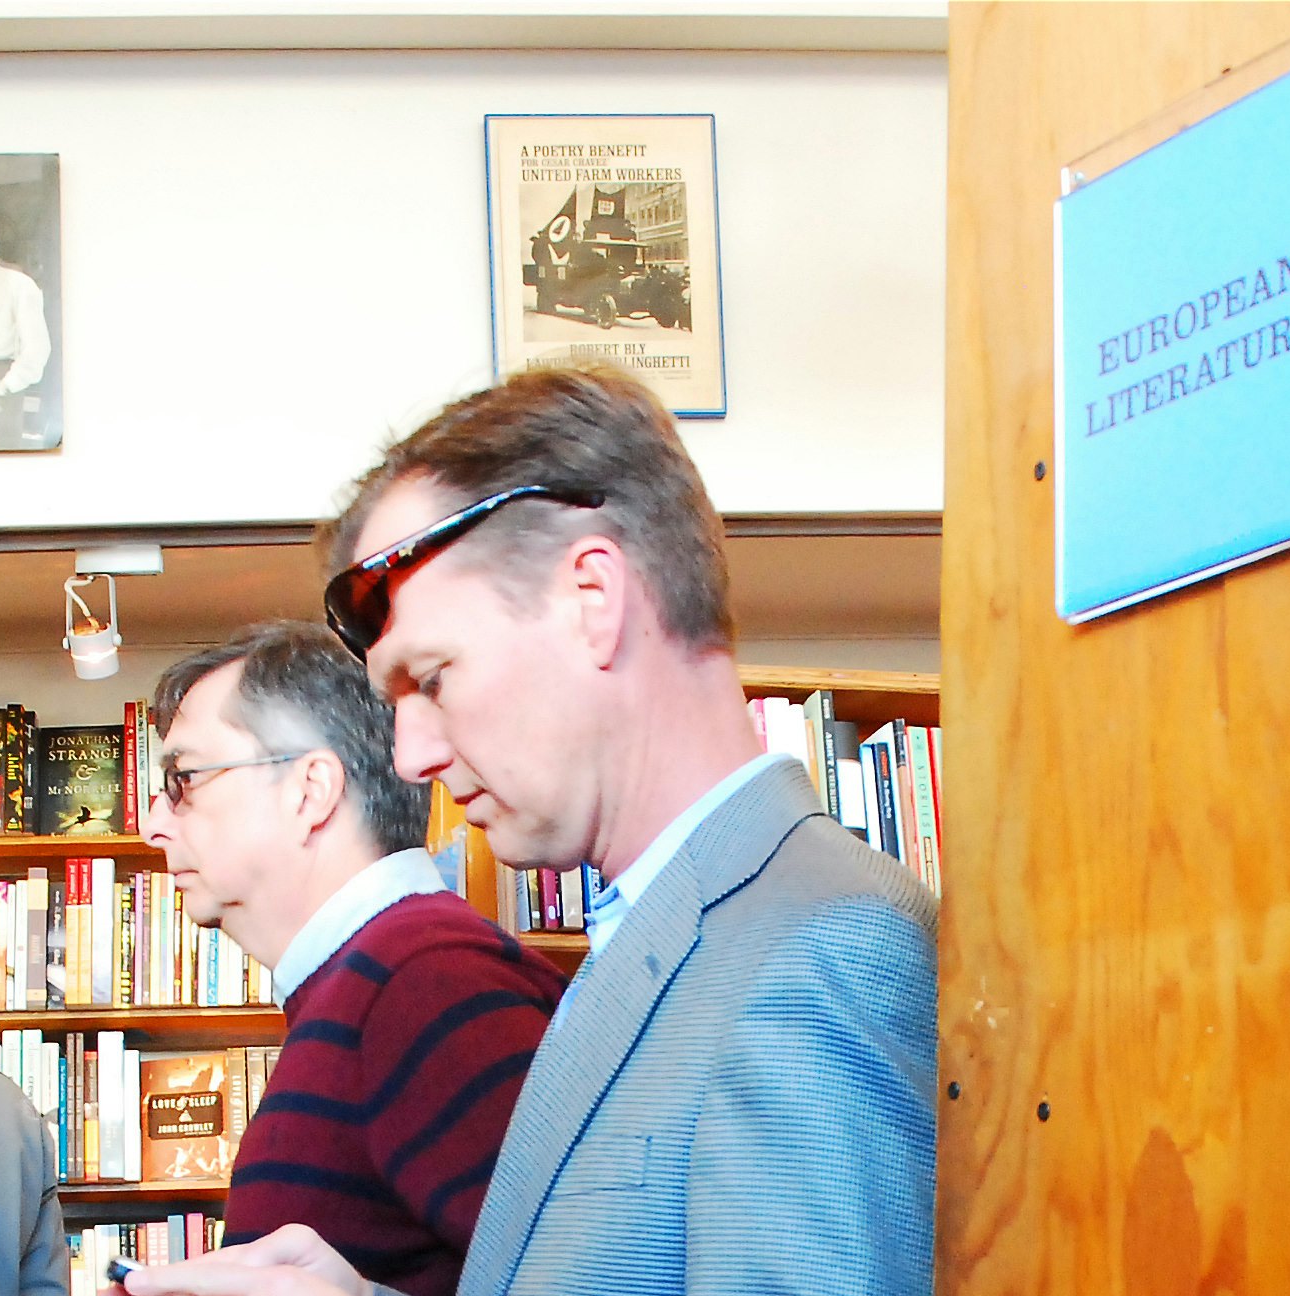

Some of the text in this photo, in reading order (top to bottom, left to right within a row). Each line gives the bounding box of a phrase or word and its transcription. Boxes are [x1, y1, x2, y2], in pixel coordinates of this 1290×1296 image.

[520, 143, 648, 158] A POETRY BENEFIT
[520, 167, 682, 183] UNITED FARM WORKERS
[624, 342, 647, 355] BLY
[49, 734, 121, 749] JONATHAN
[824, 731, 835, 767] ABOUT
[48, 747, 121, 762] STRANGE
[75, 763, 101, 782] &
[64, 783, 122, 796] NORRELL
[917, 763, 932, 830] STORIES
[152, 1097, 176, 1111] LOVE
[189, 1095, 217, 1108] SLEEP
[157, 1121, 215, 1135] JOHN CROWLEY
